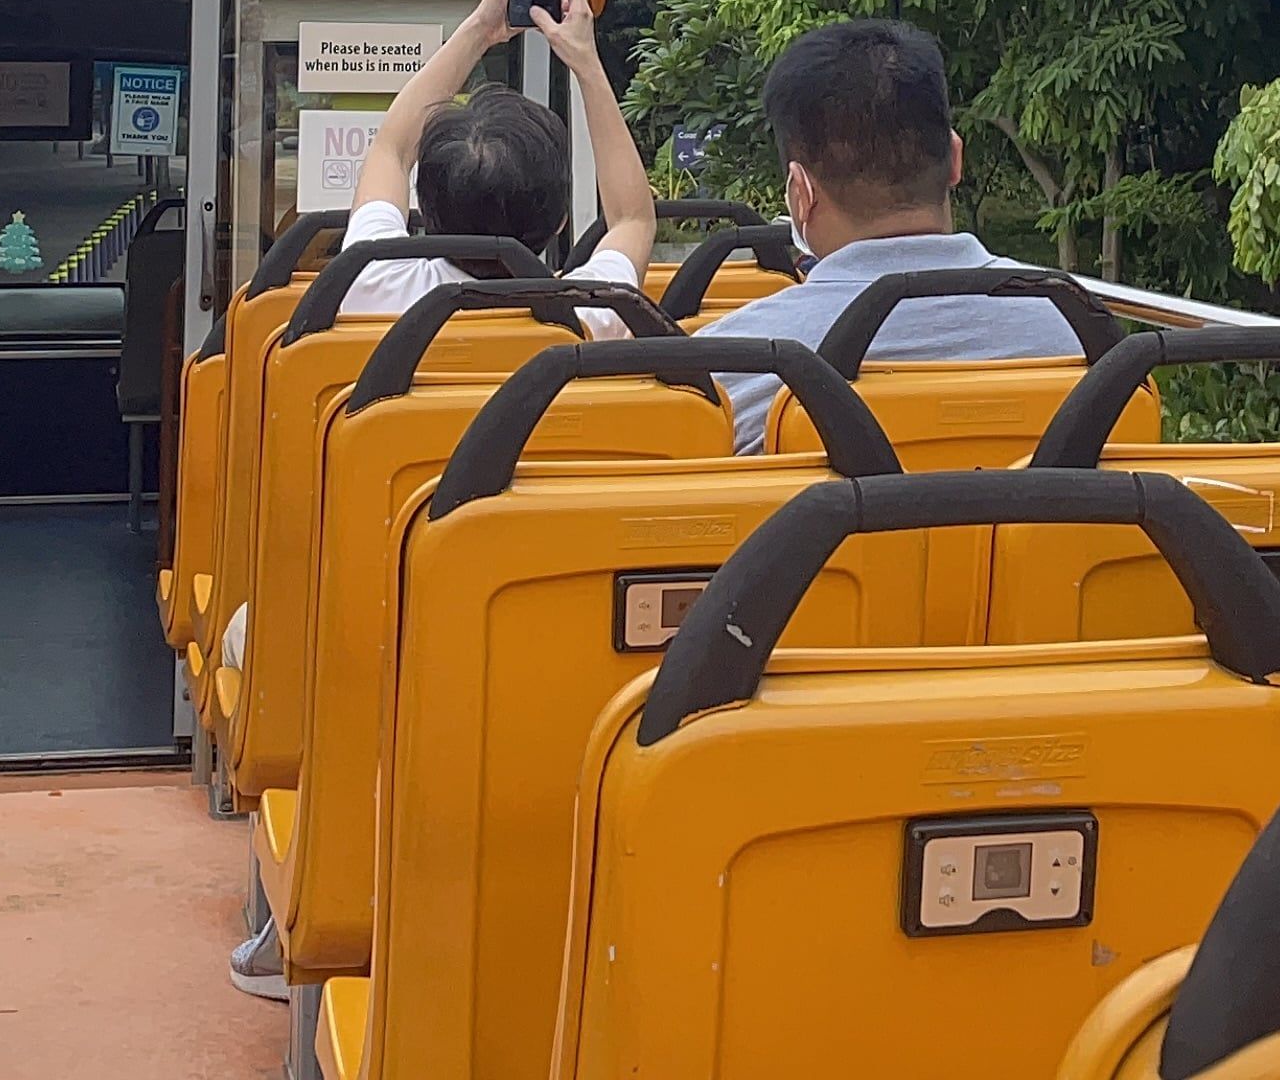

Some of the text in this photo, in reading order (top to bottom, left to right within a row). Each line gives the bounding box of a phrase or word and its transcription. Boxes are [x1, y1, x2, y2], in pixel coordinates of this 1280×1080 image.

[321, 42, 421, 56] Please be seated
[305, 59, 338, 71] when
[342, 59, 363, 72] bus
[366, 59, 375, 71] is
[378, 59, 390, 72] in
[122, 77, 174, 90] NOTICE
[325, 127, 365, 156] NO
